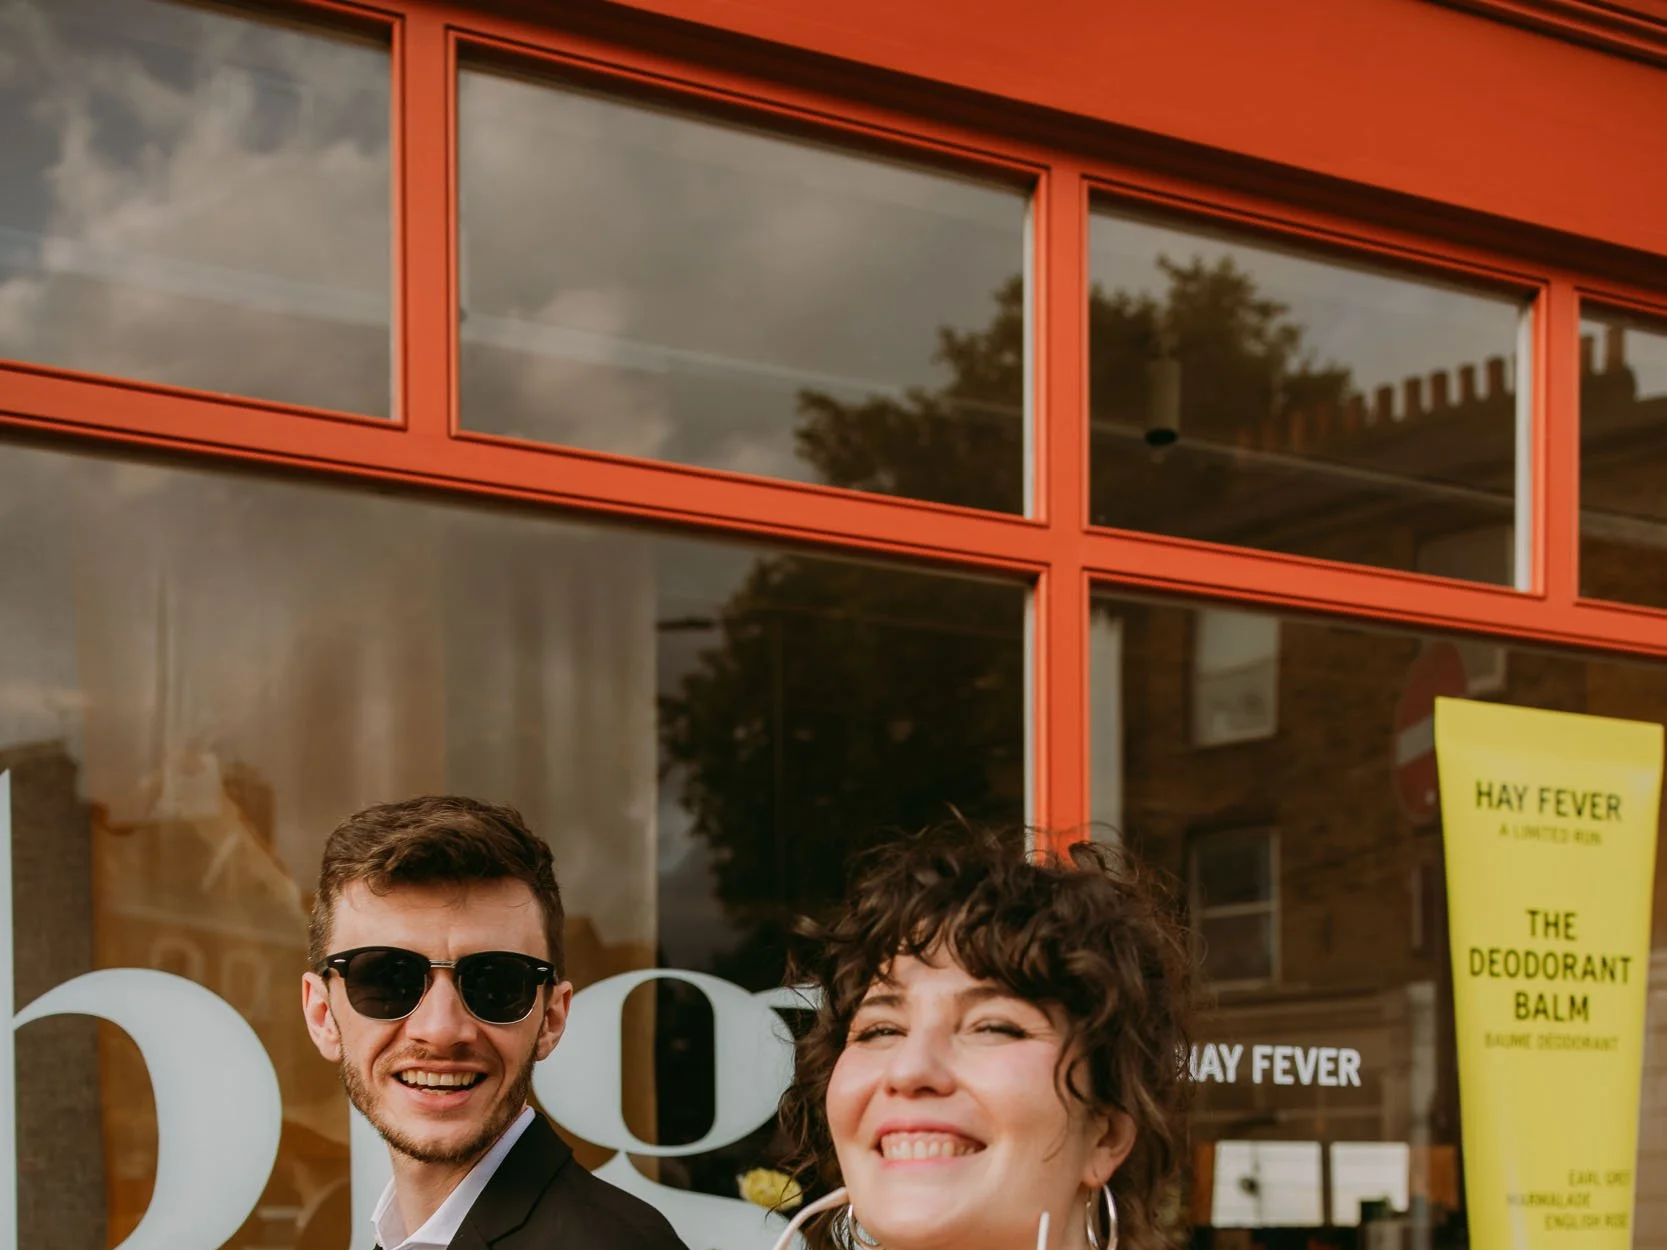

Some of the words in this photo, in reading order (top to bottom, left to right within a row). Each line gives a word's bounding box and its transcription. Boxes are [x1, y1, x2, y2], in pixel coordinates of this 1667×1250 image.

[1475, 779, 1528, 811] HAY
[1538, 786, 1622, 822] FEVER
[1526, 909, 1577, 942] THE
[1468, 947, 1632, 984] DEODORANT
[1514, 991, 1590, 1023] BALM
[1251, 1044, 1362, 1087] FEVER
